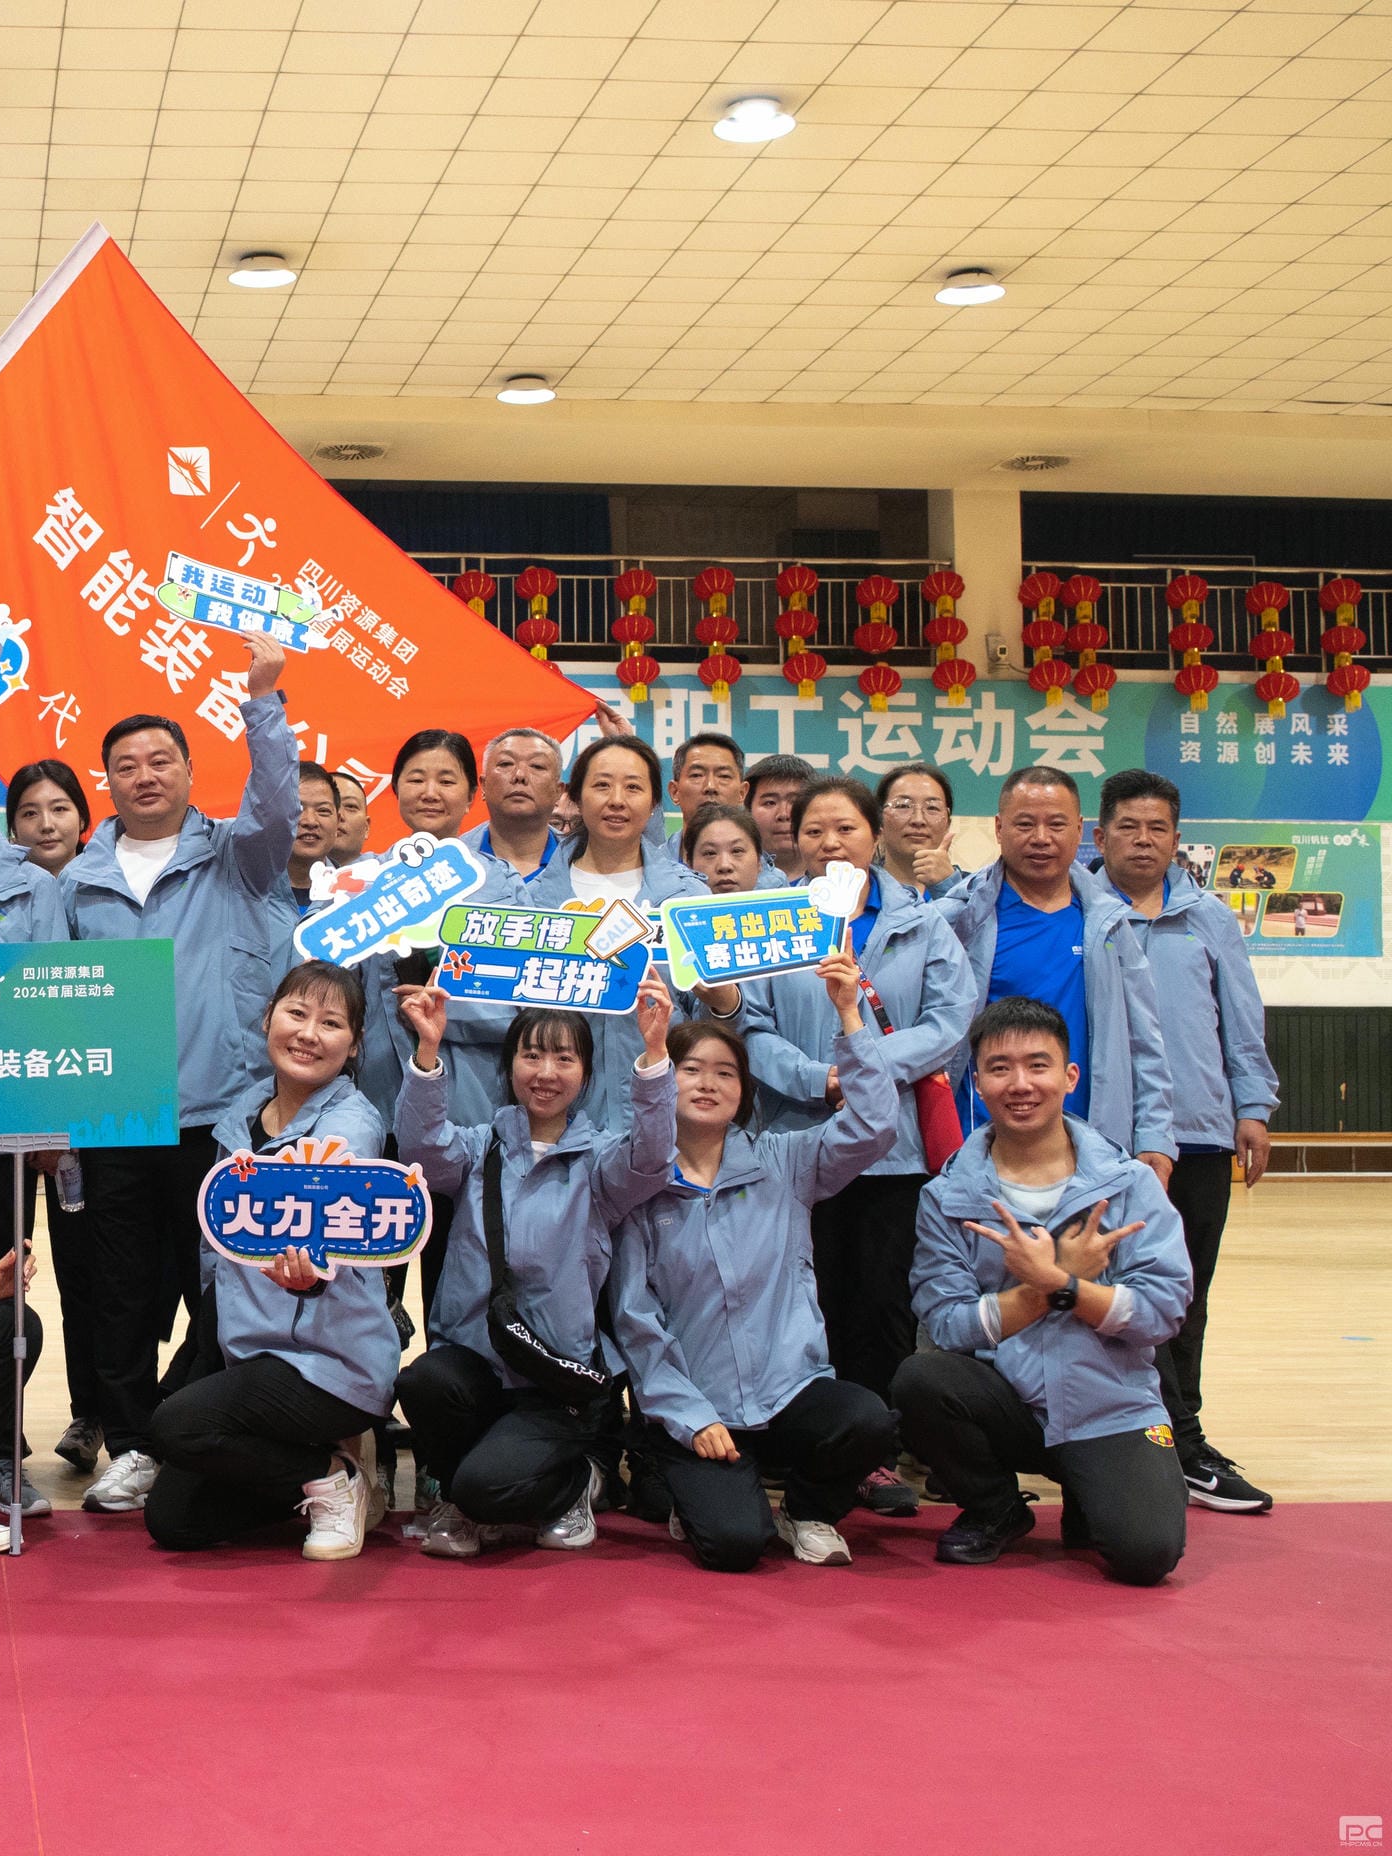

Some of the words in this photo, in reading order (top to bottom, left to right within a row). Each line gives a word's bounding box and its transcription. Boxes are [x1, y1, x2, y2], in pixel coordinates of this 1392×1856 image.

[181, 563, 266, 606] 我运动
[208, 600, 294, 645] 我健康
[297, 558, 419, 664] 四川资源集团
[1180, 711, 1349, 737] 自然展风采
[1179, 740, 1350, 766] 资源创未来
[320, 858, 463, 960] 大力出奇迹
[711, 905, 824, 941] 秀出风采
[461, 910, 575, 951] 放手博
[596, 918, 635, 951] CALL
[704, 935, 818, 970] 赛出水平
[13, 984, 115, 999] 2024首届运动会
[22, 965, 105, 980] 四川资源集团
[474, 955, 610, 1006] 一起拼
[222, 1193, 414, 1241] 火力全开
